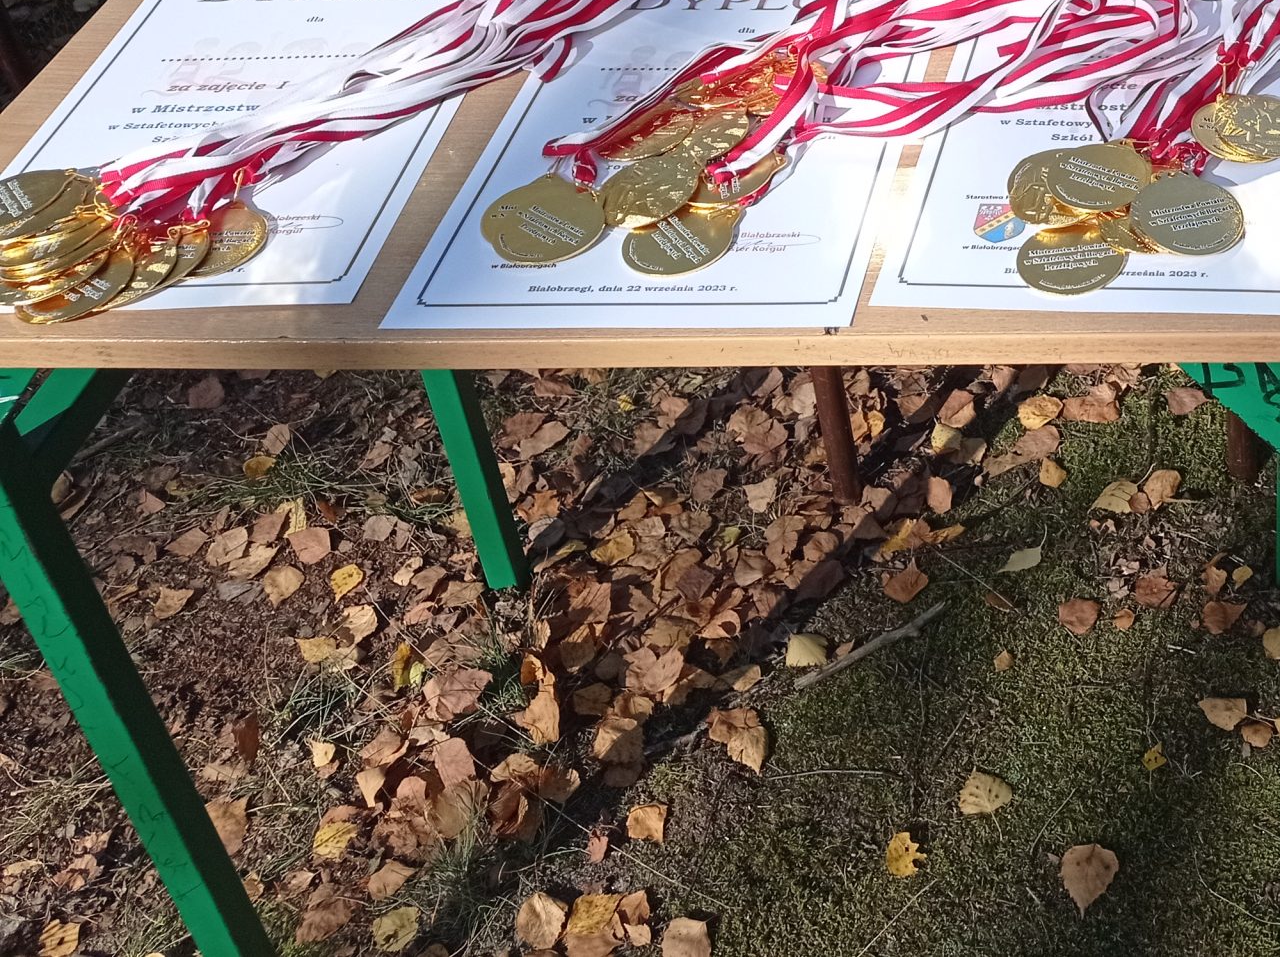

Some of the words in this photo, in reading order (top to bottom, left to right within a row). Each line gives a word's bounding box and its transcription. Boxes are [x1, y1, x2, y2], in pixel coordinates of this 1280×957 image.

[306, 15, 324, 23] dla
[167, 84, 191, 92] za
[194, 81, 267, 93] zajęcie
[131, 106, 147, 114] w
[644, 284, 694, 292] września
